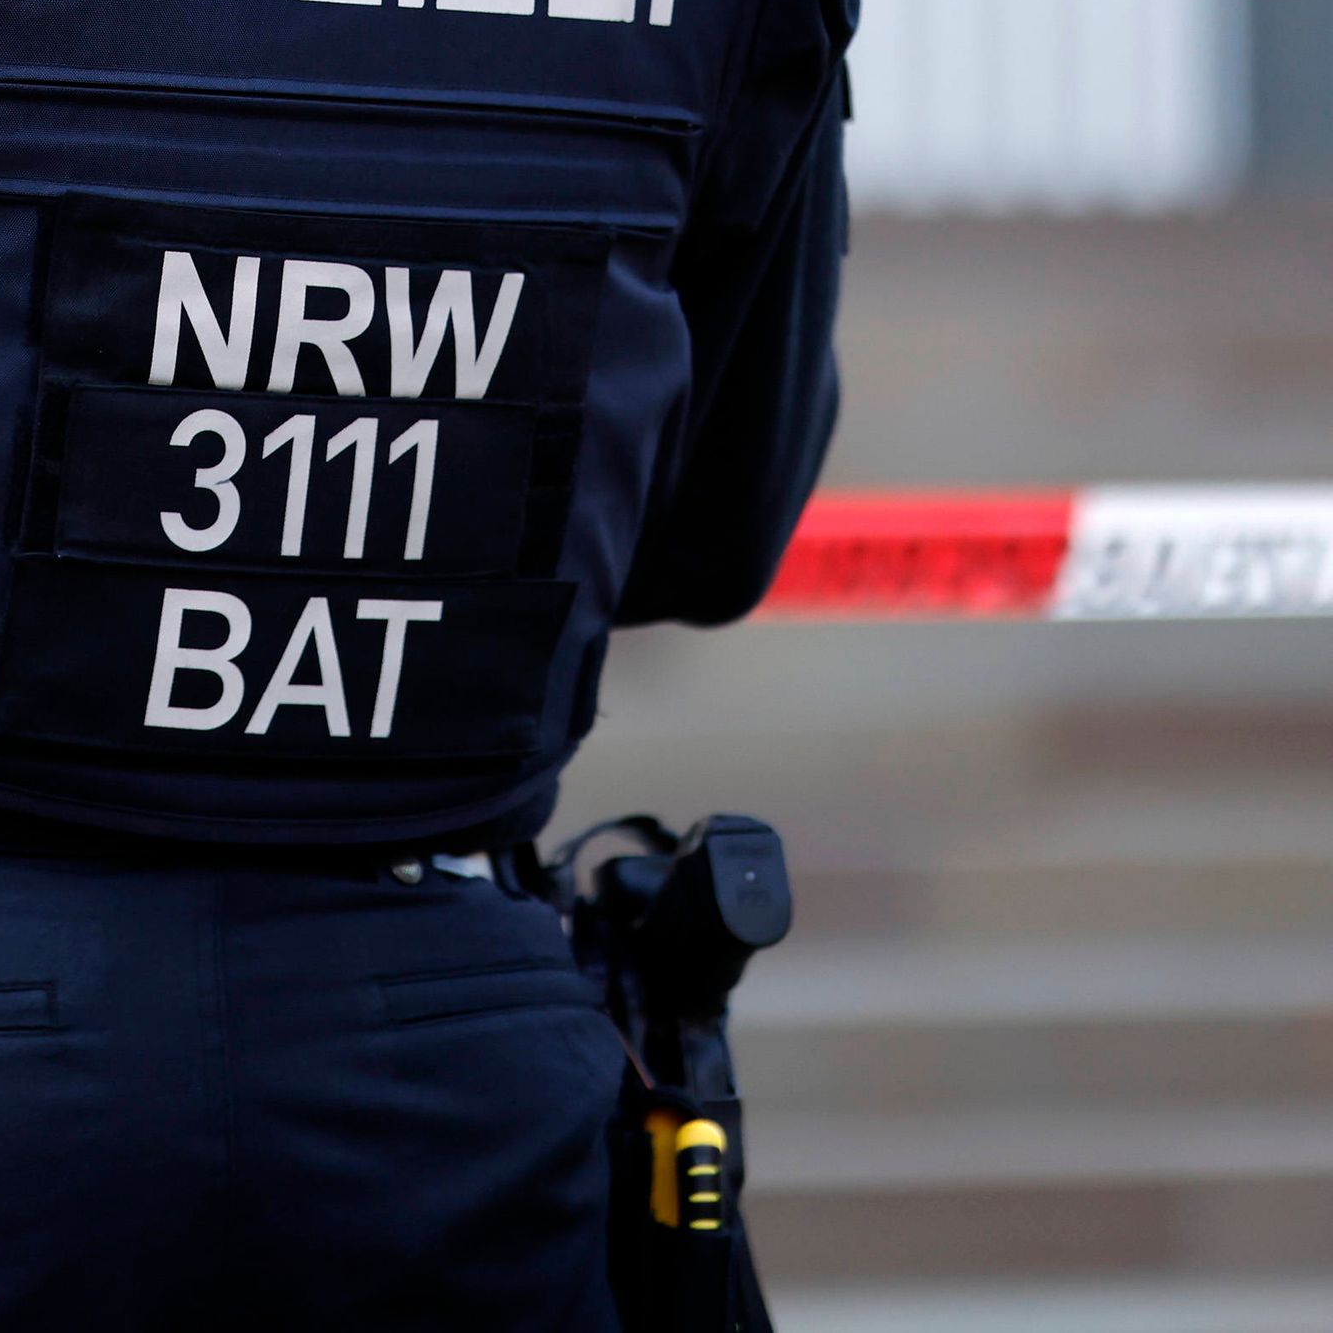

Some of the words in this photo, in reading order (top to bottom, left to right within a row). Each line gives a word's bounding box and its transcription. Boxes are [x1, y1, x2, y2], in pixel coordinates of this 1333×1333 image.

[147, 250, 525, 400] NRW
[159, 409, 439, 561] 3111
[144, 587, 444, 739] BAT
